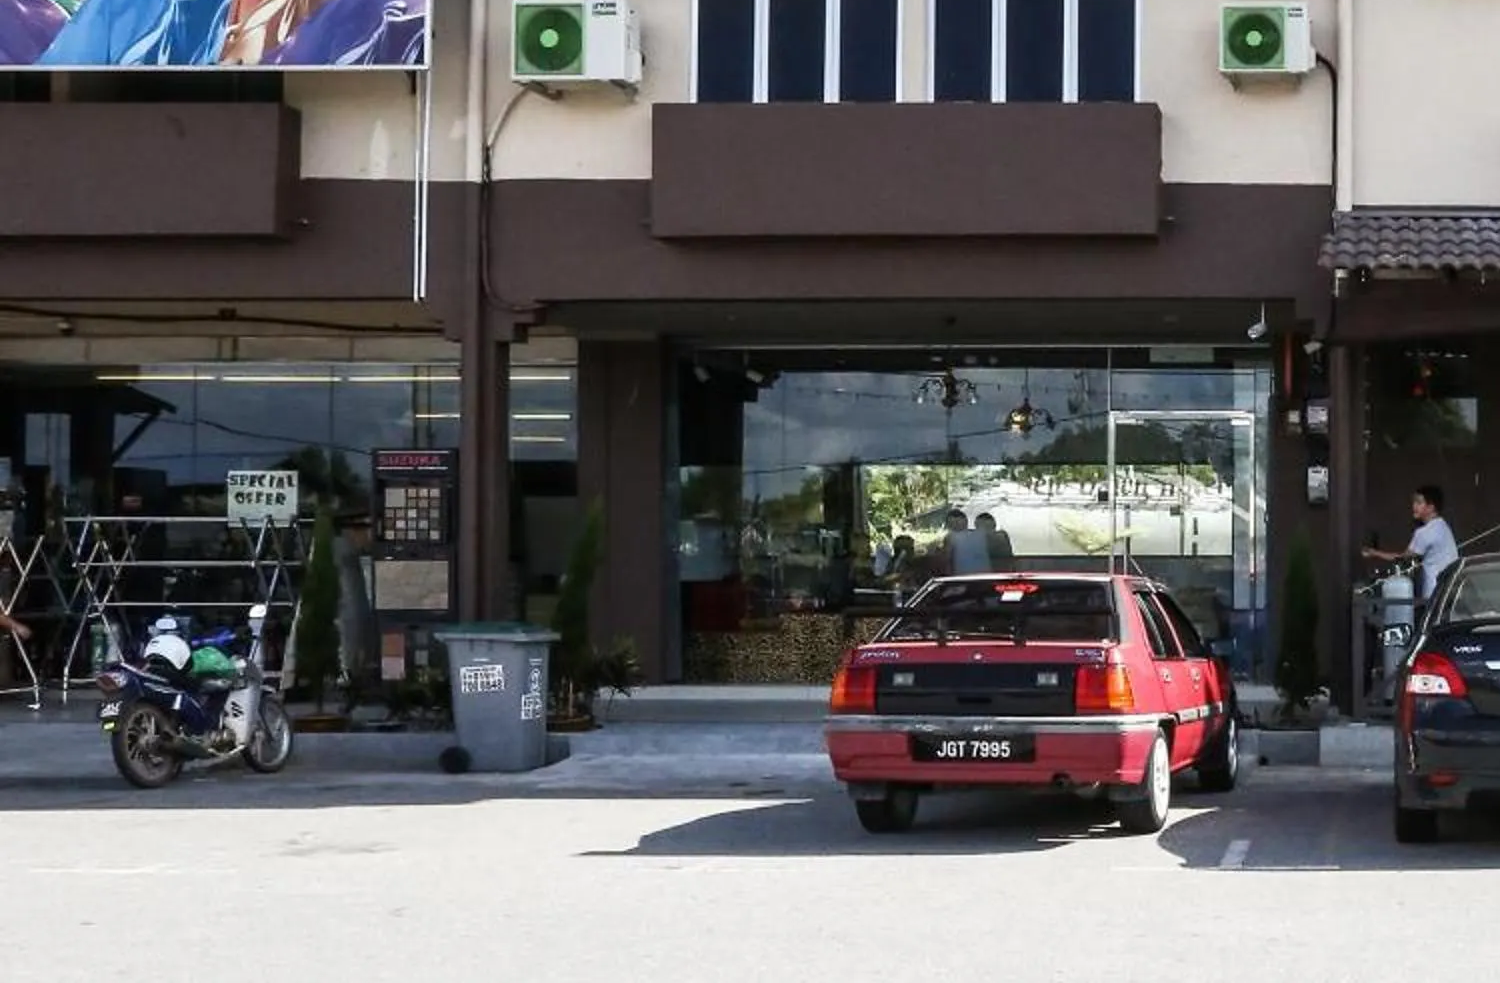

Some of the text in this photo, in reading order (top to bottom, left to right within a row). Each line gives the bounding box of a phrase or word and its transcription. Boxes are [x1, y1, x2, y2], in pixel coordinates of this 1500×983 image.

[228, 473, 296, 490] SPECIAL
[235, 491, 287, 506] OFFER
[936, 740, 1011, 758] JGT 7995
